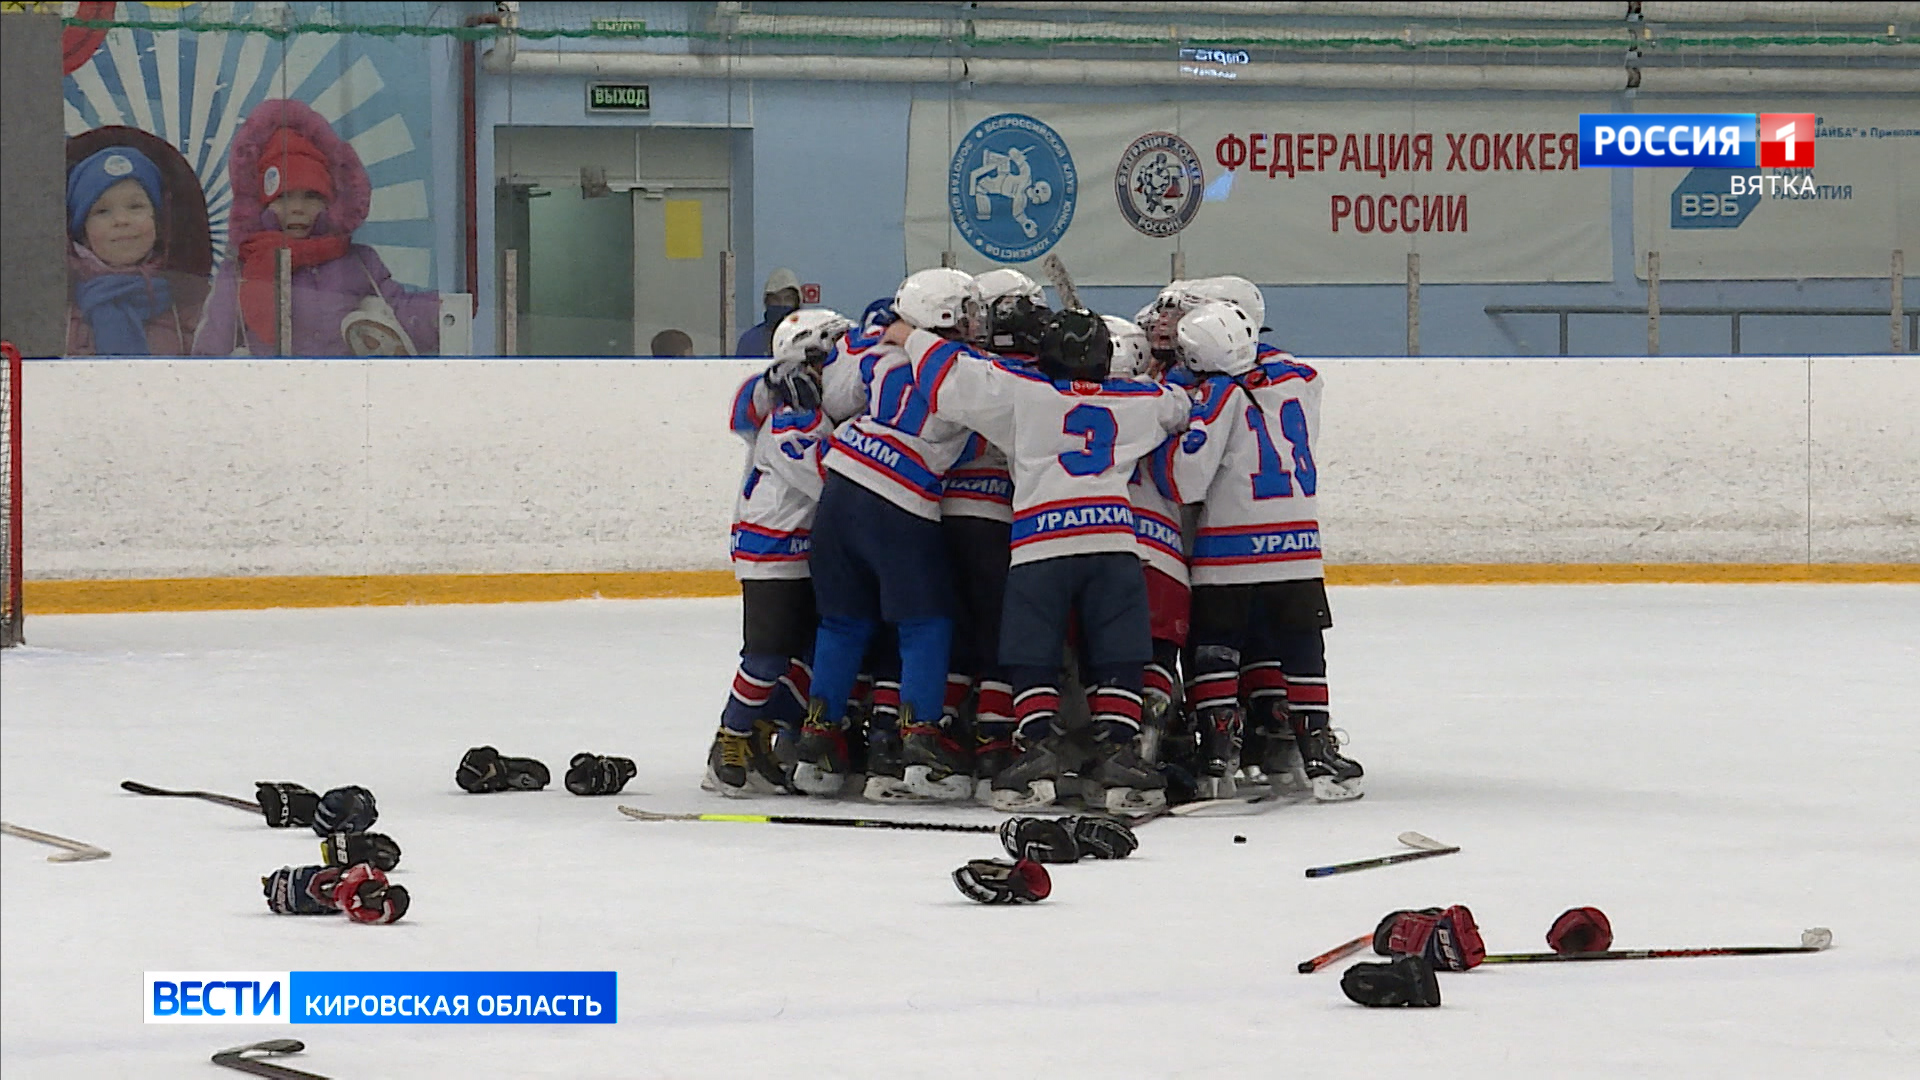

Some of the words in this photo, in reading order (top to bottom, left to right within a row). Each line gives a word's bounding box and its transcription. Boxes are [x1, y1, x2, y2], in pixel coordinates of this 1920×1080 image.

[595, 87, 646, 106] ВЫХОД
[1215, 133, 1433, 179] ФЕДЕРАЦИЯ
[1446, 133, 1579, 171] ХОККЕЯ
[1331, 194, 1468, 233] РОССИИ
[1680, 193, 1740, 217] ВЭБ
[1058, 403, 1118, 477] 3
[1245, 398, 1317, 500] 18
